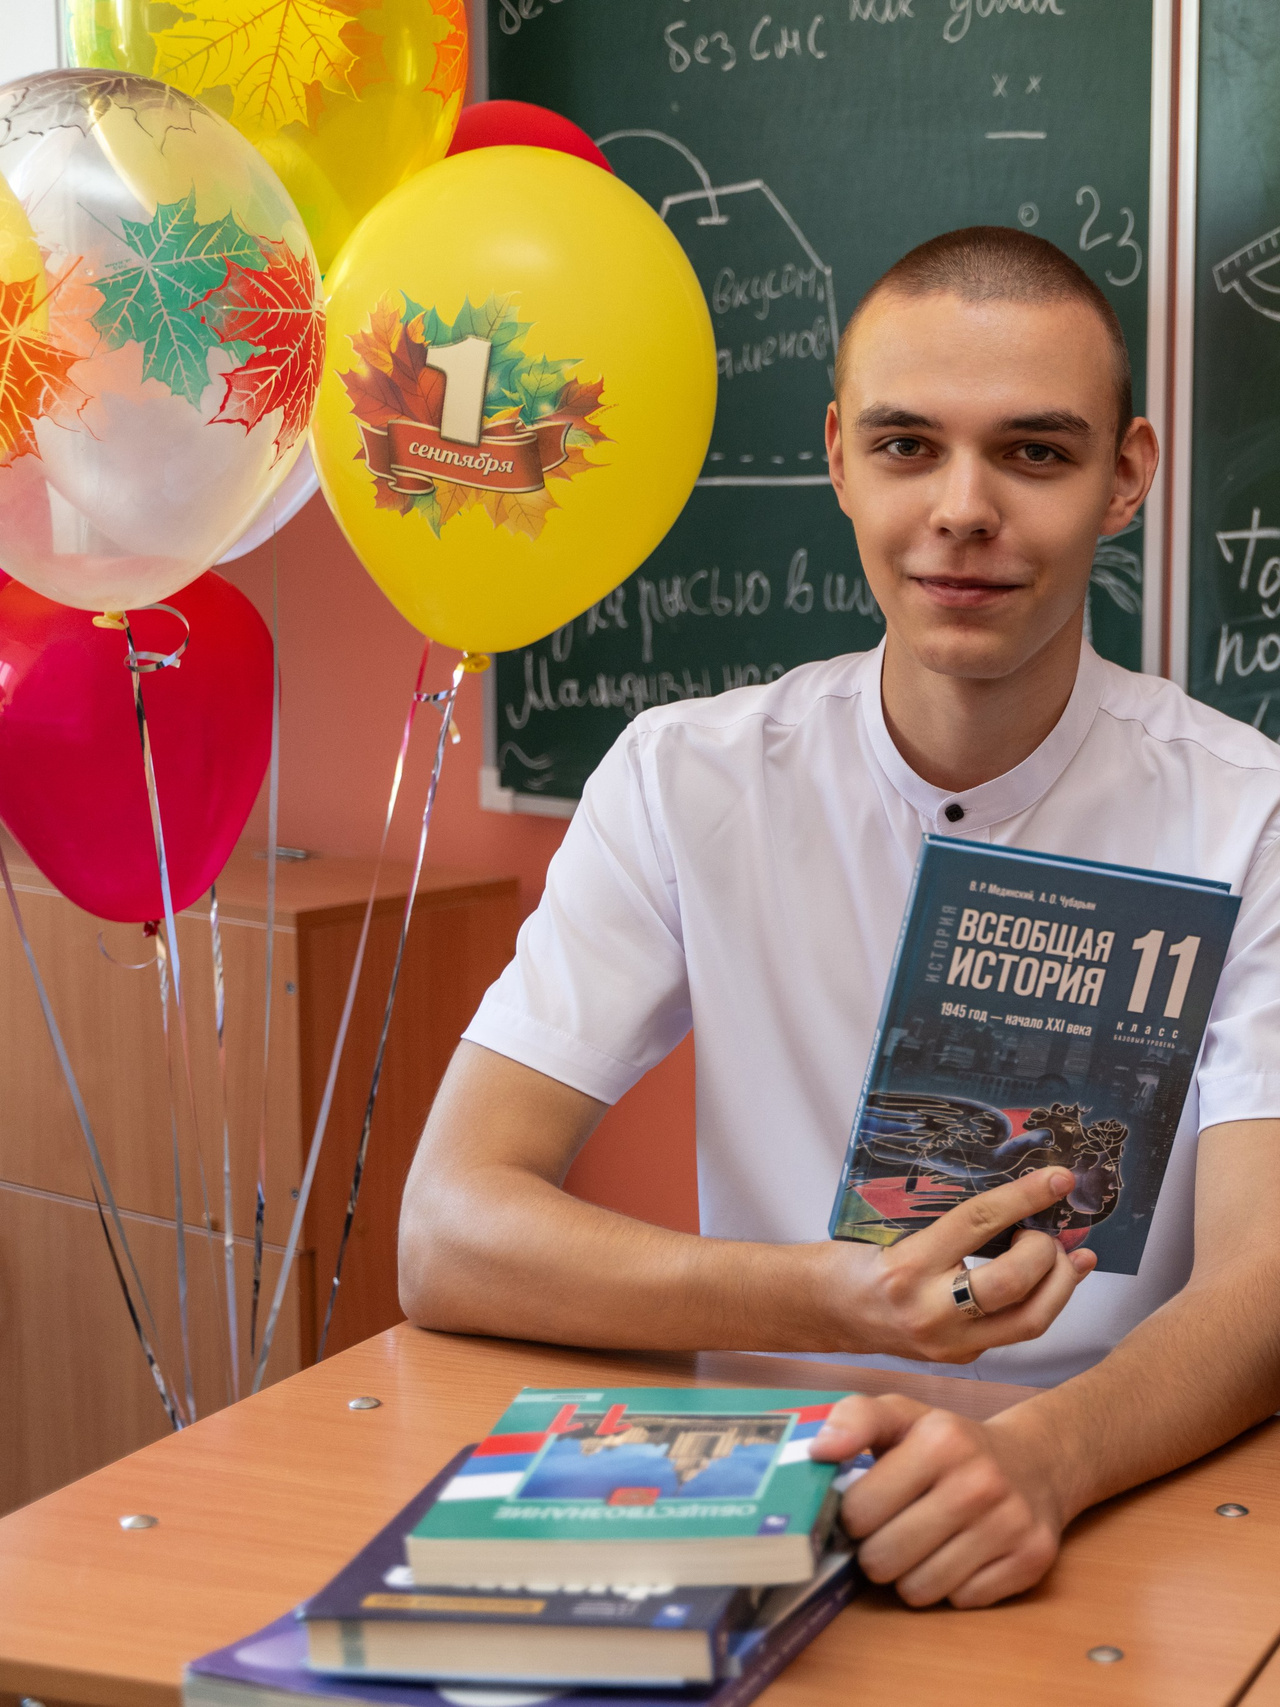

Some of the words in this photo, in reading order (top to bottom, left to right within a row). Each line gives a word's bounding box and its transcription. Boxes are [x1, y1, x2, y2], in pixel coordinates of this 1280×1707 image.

[424, 334, 496, 448] 1
[406, 437, 516, 477] сентября
[1059, 895, 1097, 911] Чубарьян
[926, 906, 956, 982] ИСТОРИЯ
[957, 909, 1114, 962] ВСЕОБЩАЯ
[947, 947, 1105, 1006] ИСТОРИЯ
[1128, 930, 1200, 1018] 11
[941, 1002, 967, 1018] 1945
[967, 1008, 988, 1023] год
[1004, 1014, 1044, 1030] начало
[1066, 1023, 1093, 1037] века
[546, 1404, 631, 1434] 11
[492, 1504, 757, 1521] ОБЩЕСТВОЗНАНИЕ
